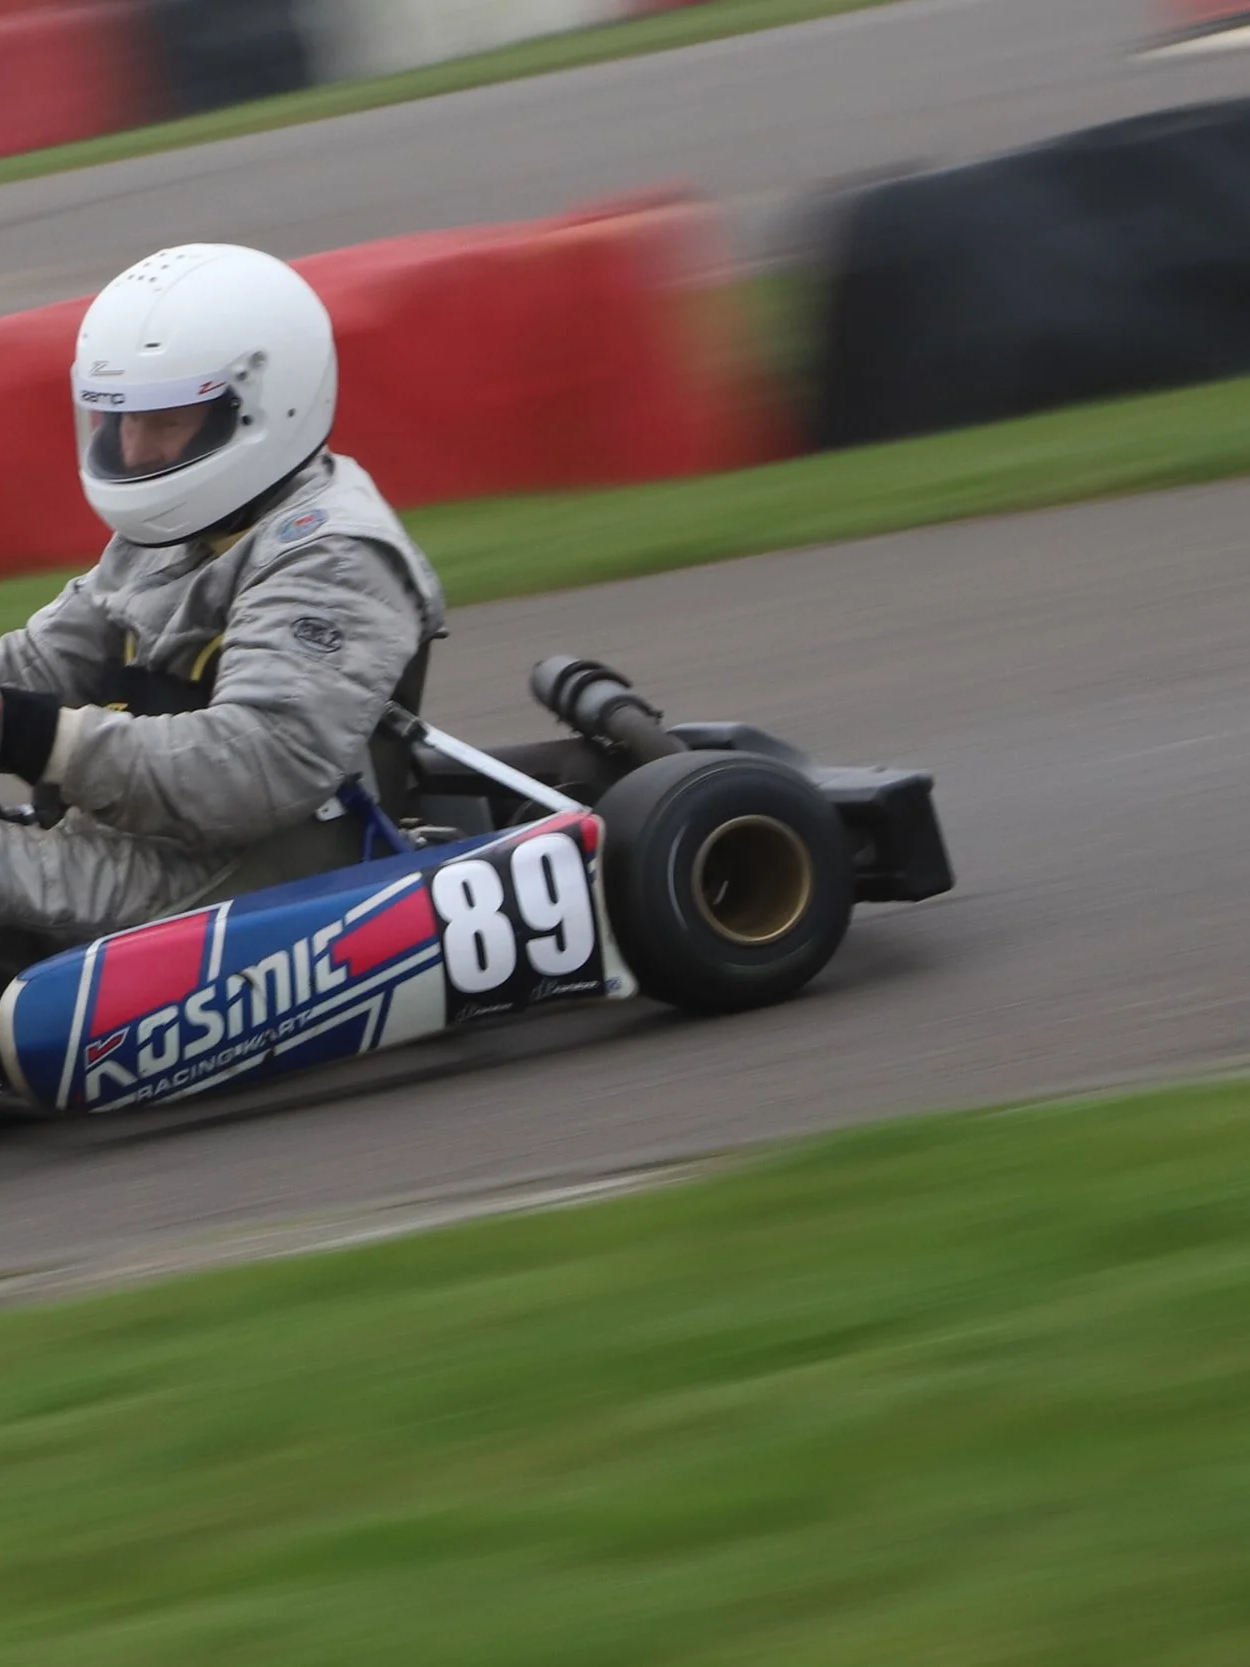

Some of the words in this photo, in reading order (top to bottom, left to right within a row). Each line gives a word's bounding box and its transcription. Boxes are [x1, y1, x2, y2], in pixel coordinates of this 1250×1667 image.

[431, 832, 594, 993] 89
[85, 919, 347, 1102] KOSMIC
[133, 1048, 242, 1102] RACING
